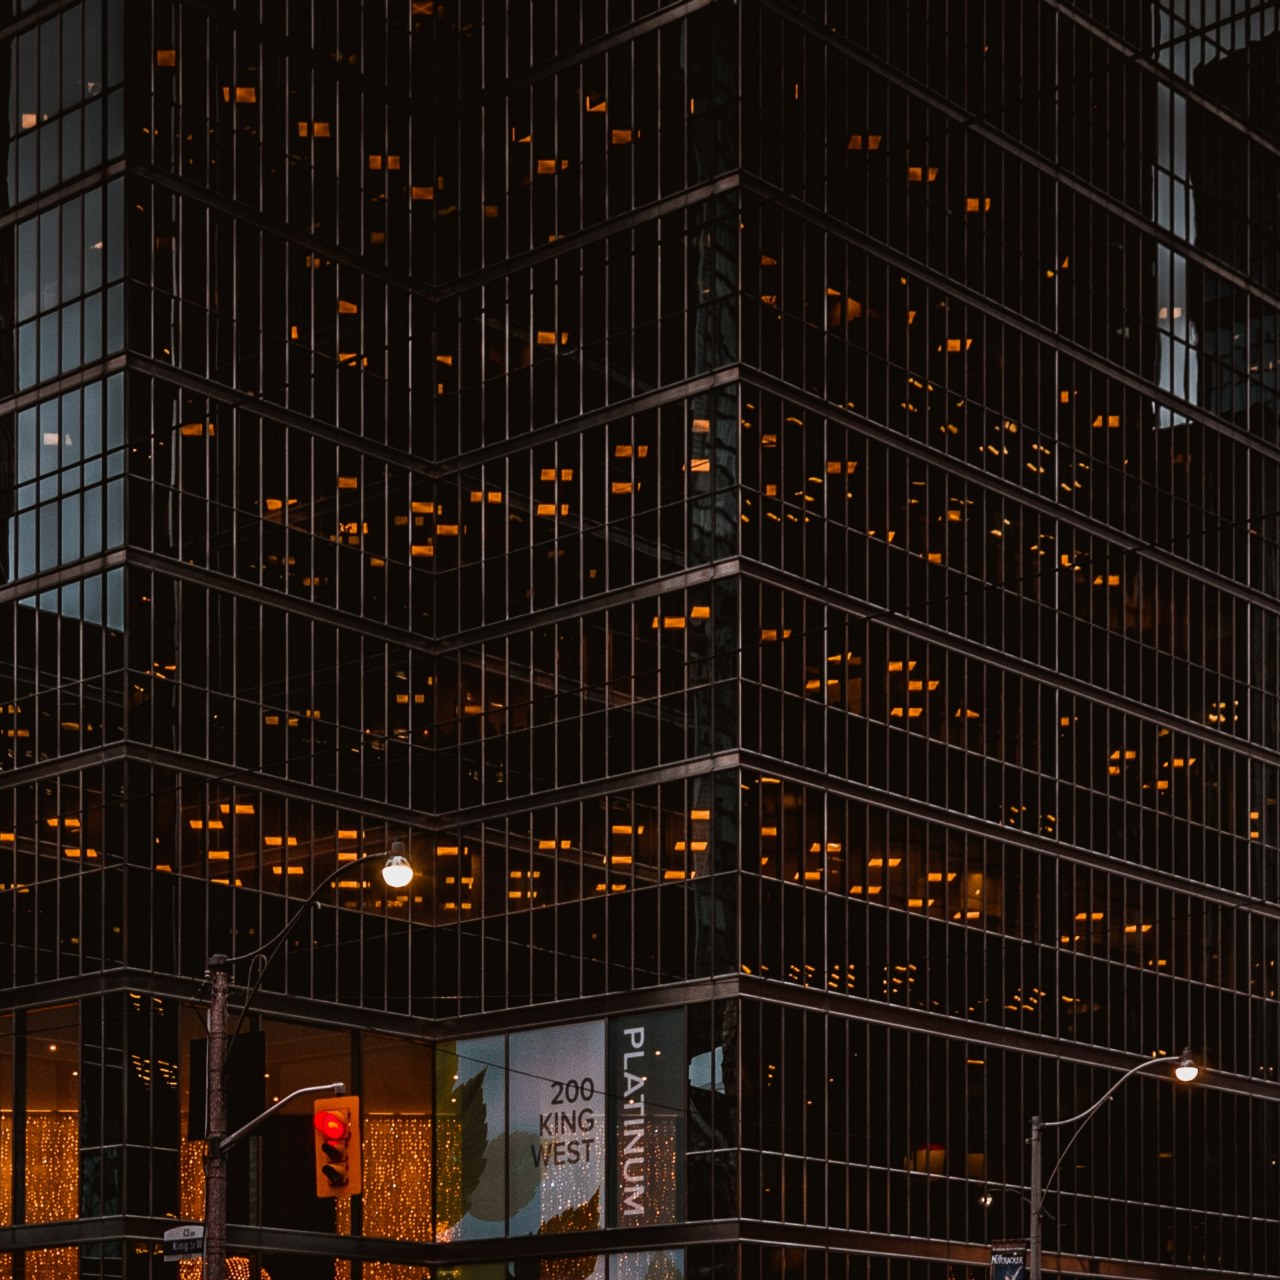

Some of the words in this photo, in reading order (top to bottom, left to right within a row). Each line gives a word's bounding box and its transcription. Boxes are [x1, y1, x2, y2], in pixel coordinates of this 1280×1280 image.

[551, 1077, 595, 1105] 200
[539, 1108, 595, 1137] KING
[623, 1026, 645, 1216] PLATINUM
[531, 1138, 595, 1168] WEST
[173, 1240, 188, 1252] King
